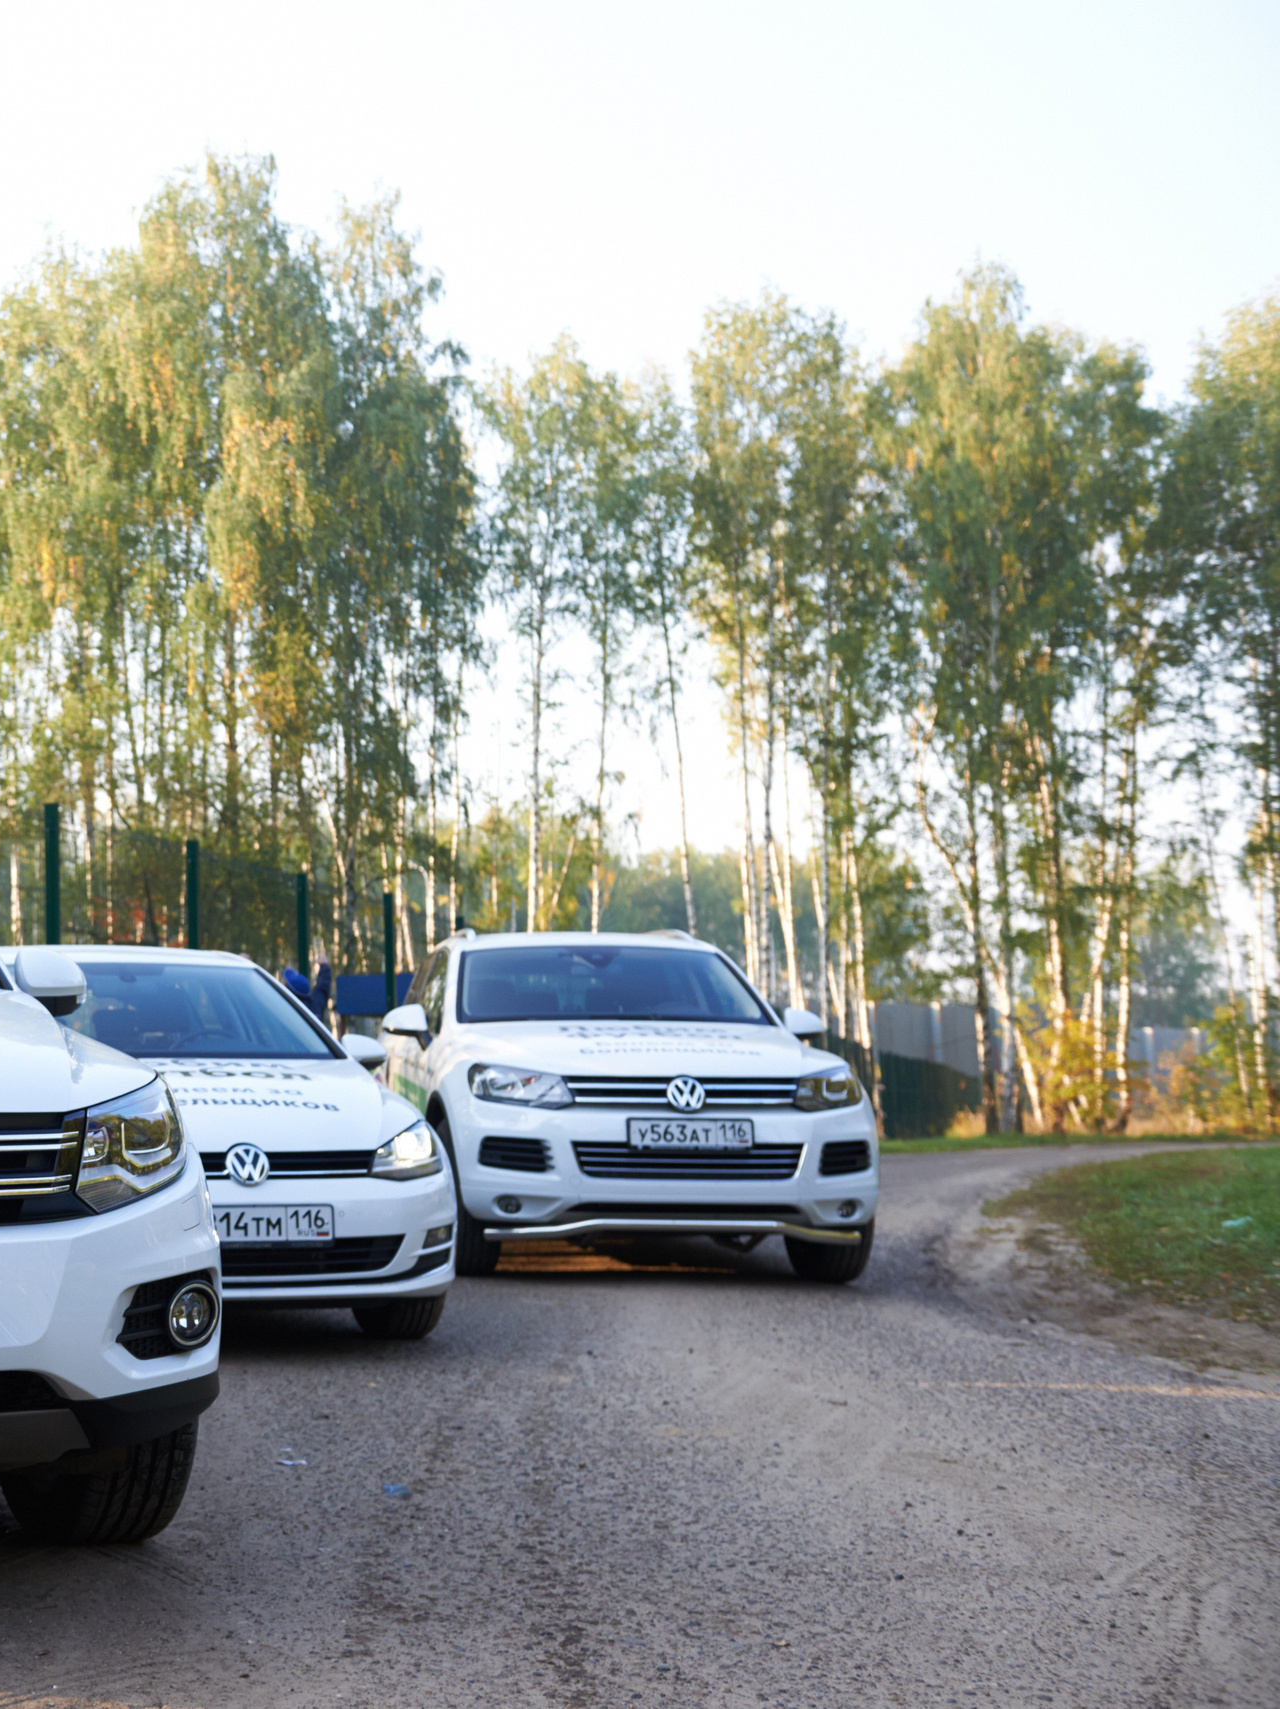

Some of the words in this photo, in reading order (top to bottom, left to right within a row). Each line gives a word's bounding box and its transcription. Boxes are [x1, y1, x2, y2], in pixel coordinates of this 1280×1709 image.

[719, 1123, 747, 1139] 116
[213, 1211, 282, 1238] 14ТМ
[289, 1209, 325, 1229] 116
